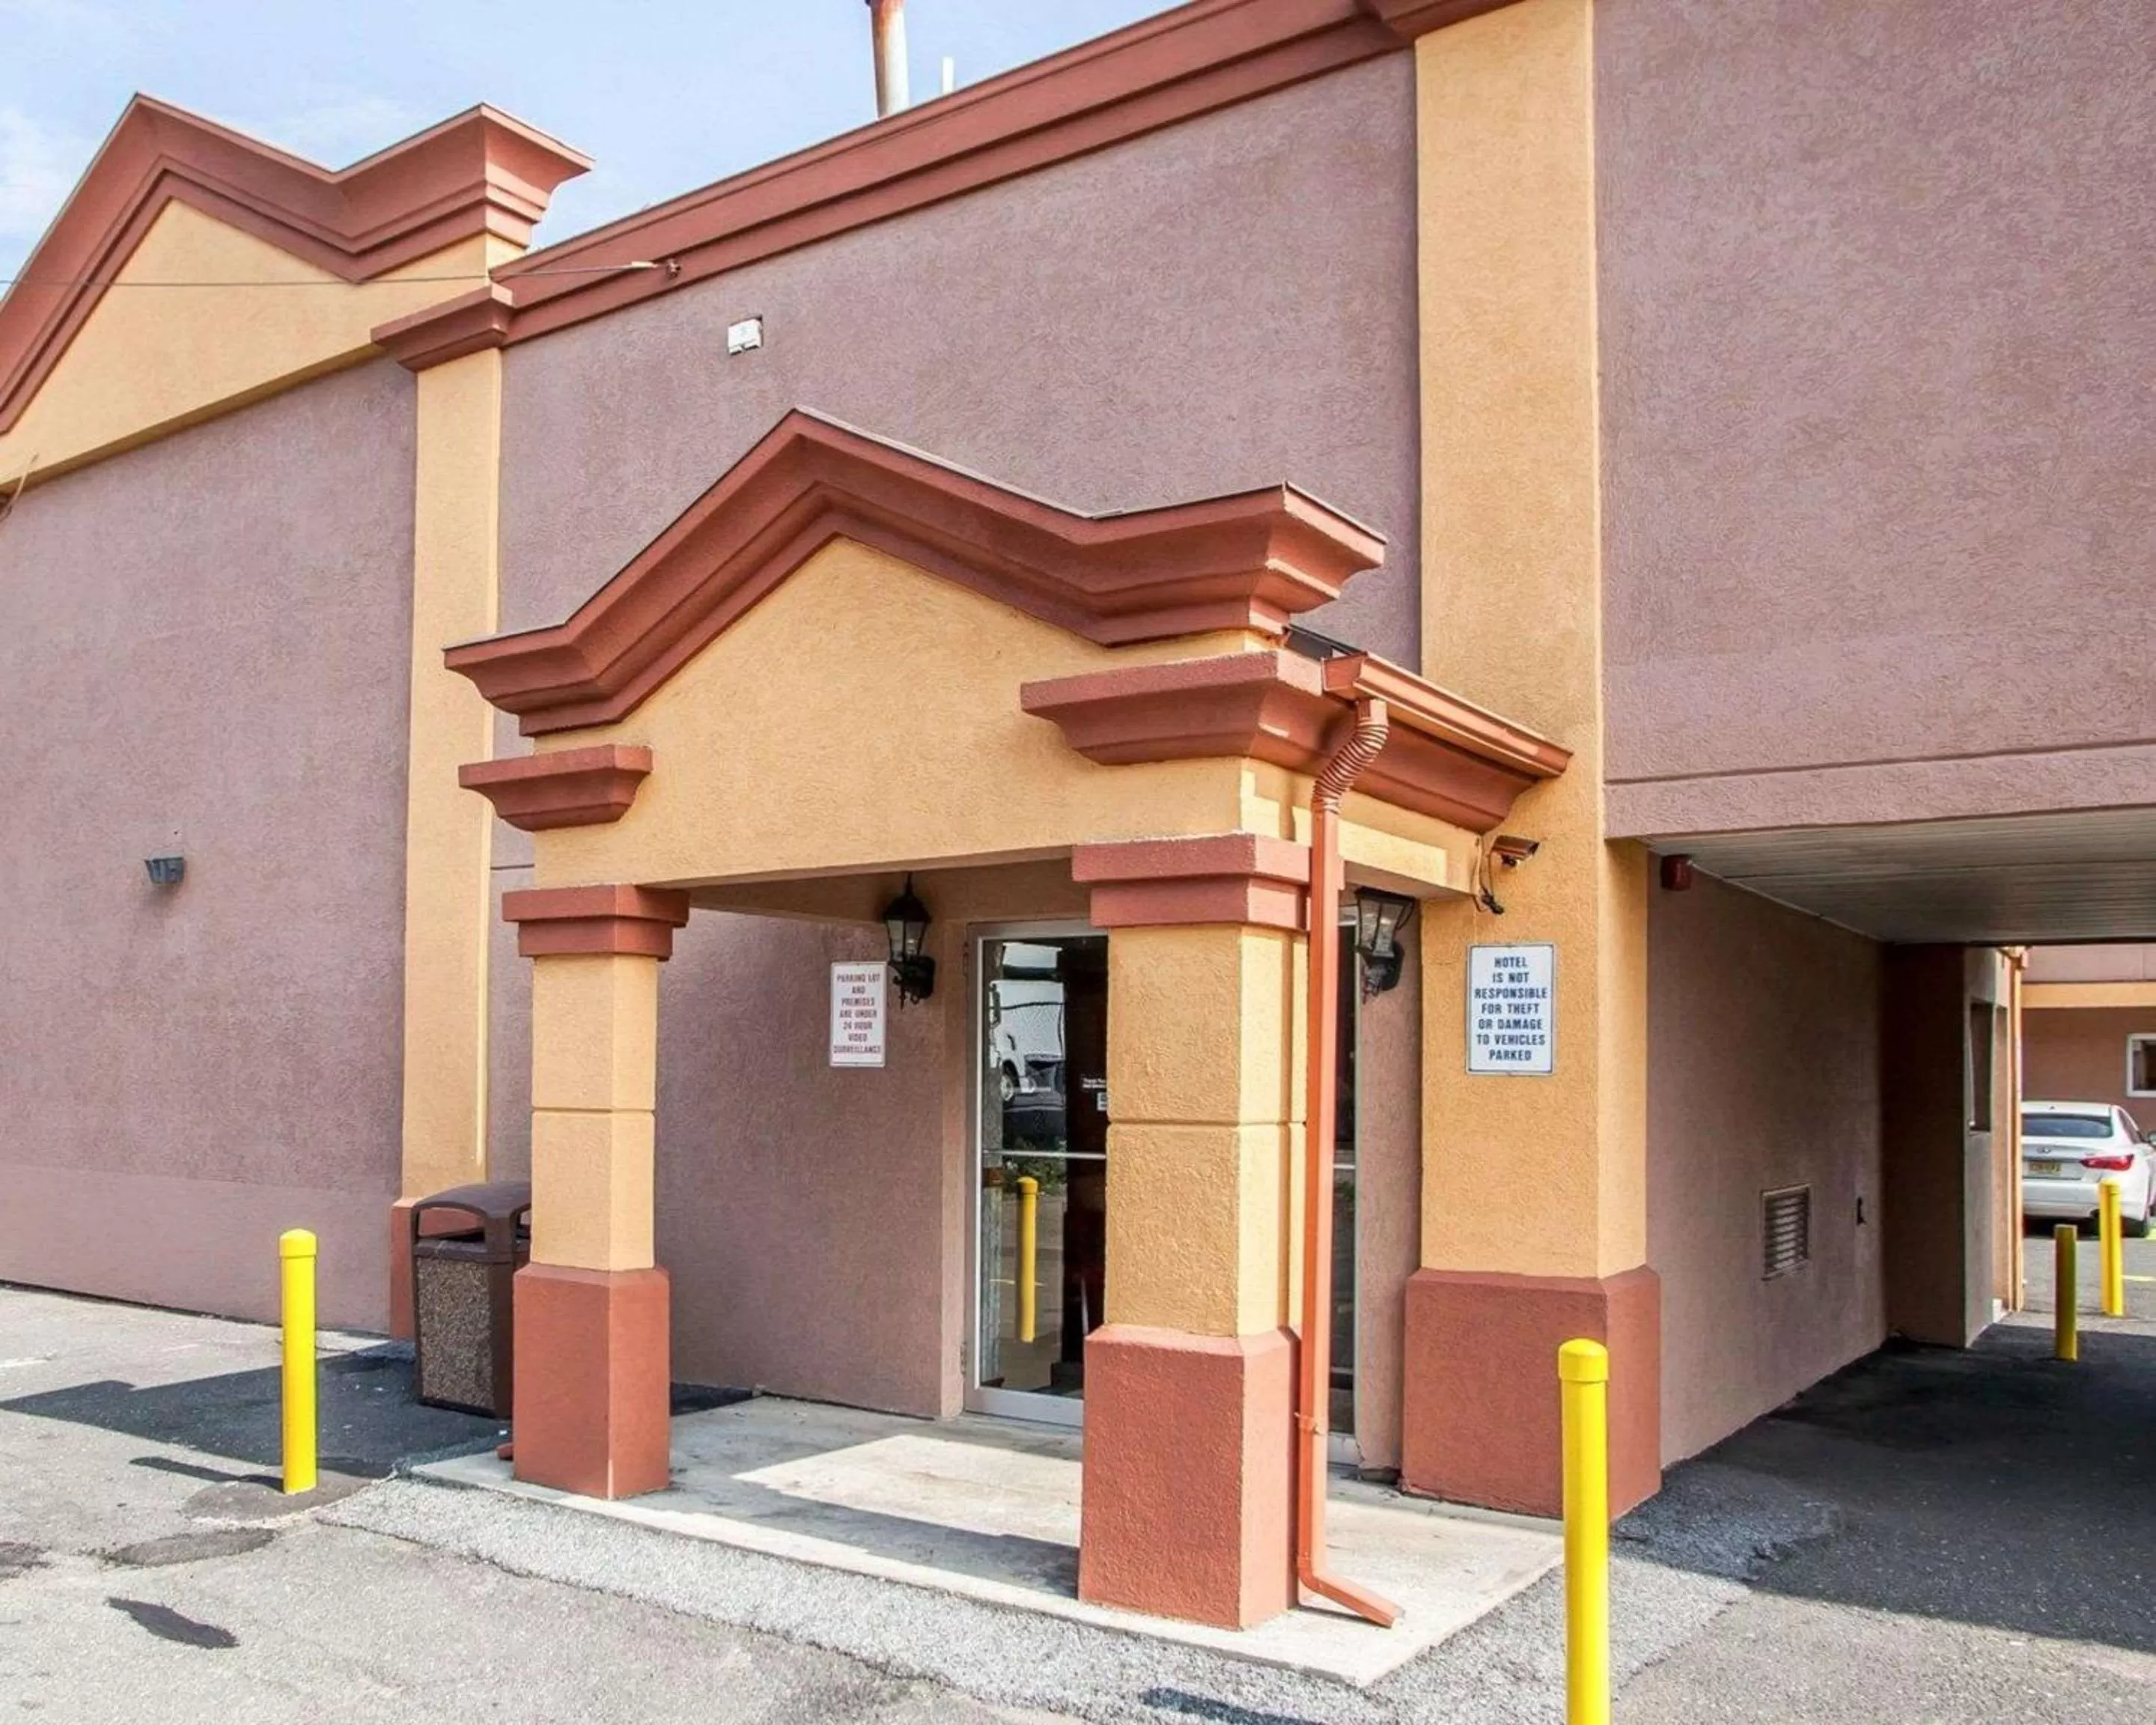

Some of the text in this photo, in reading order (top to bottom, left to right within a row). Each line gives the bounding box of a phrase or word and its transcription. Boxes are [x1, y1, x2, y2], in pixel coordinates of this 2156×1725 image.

[1494, 957, 1527, 968] HOTEL
[837, 973, 880, 982] PARKING LOT
[1493, 972, 1529, 983] IS NOT
[852, 985, 865, 994] AND
[1474, 988, 1547, 999] RESPONSIBLE
[841, 997, 874, 1006] PREMISES
[1481, 1003, 1540, 1014] FOR THEFT
[839, 1009, 877, 1018] ARE UNDER
[843, 1021, 872, 1029] 24 HOUR
[1479, 1019, 1542, 1029] OR DAMAGE
[848, 1033, 867, 1042] VIDEO
[1476, 1035, 1545, 1045] TO VEHICLES
[833, 1044, 881, 1053] SURVEILLANCE
[1489, 1050, 1532, 1061] PARKED
